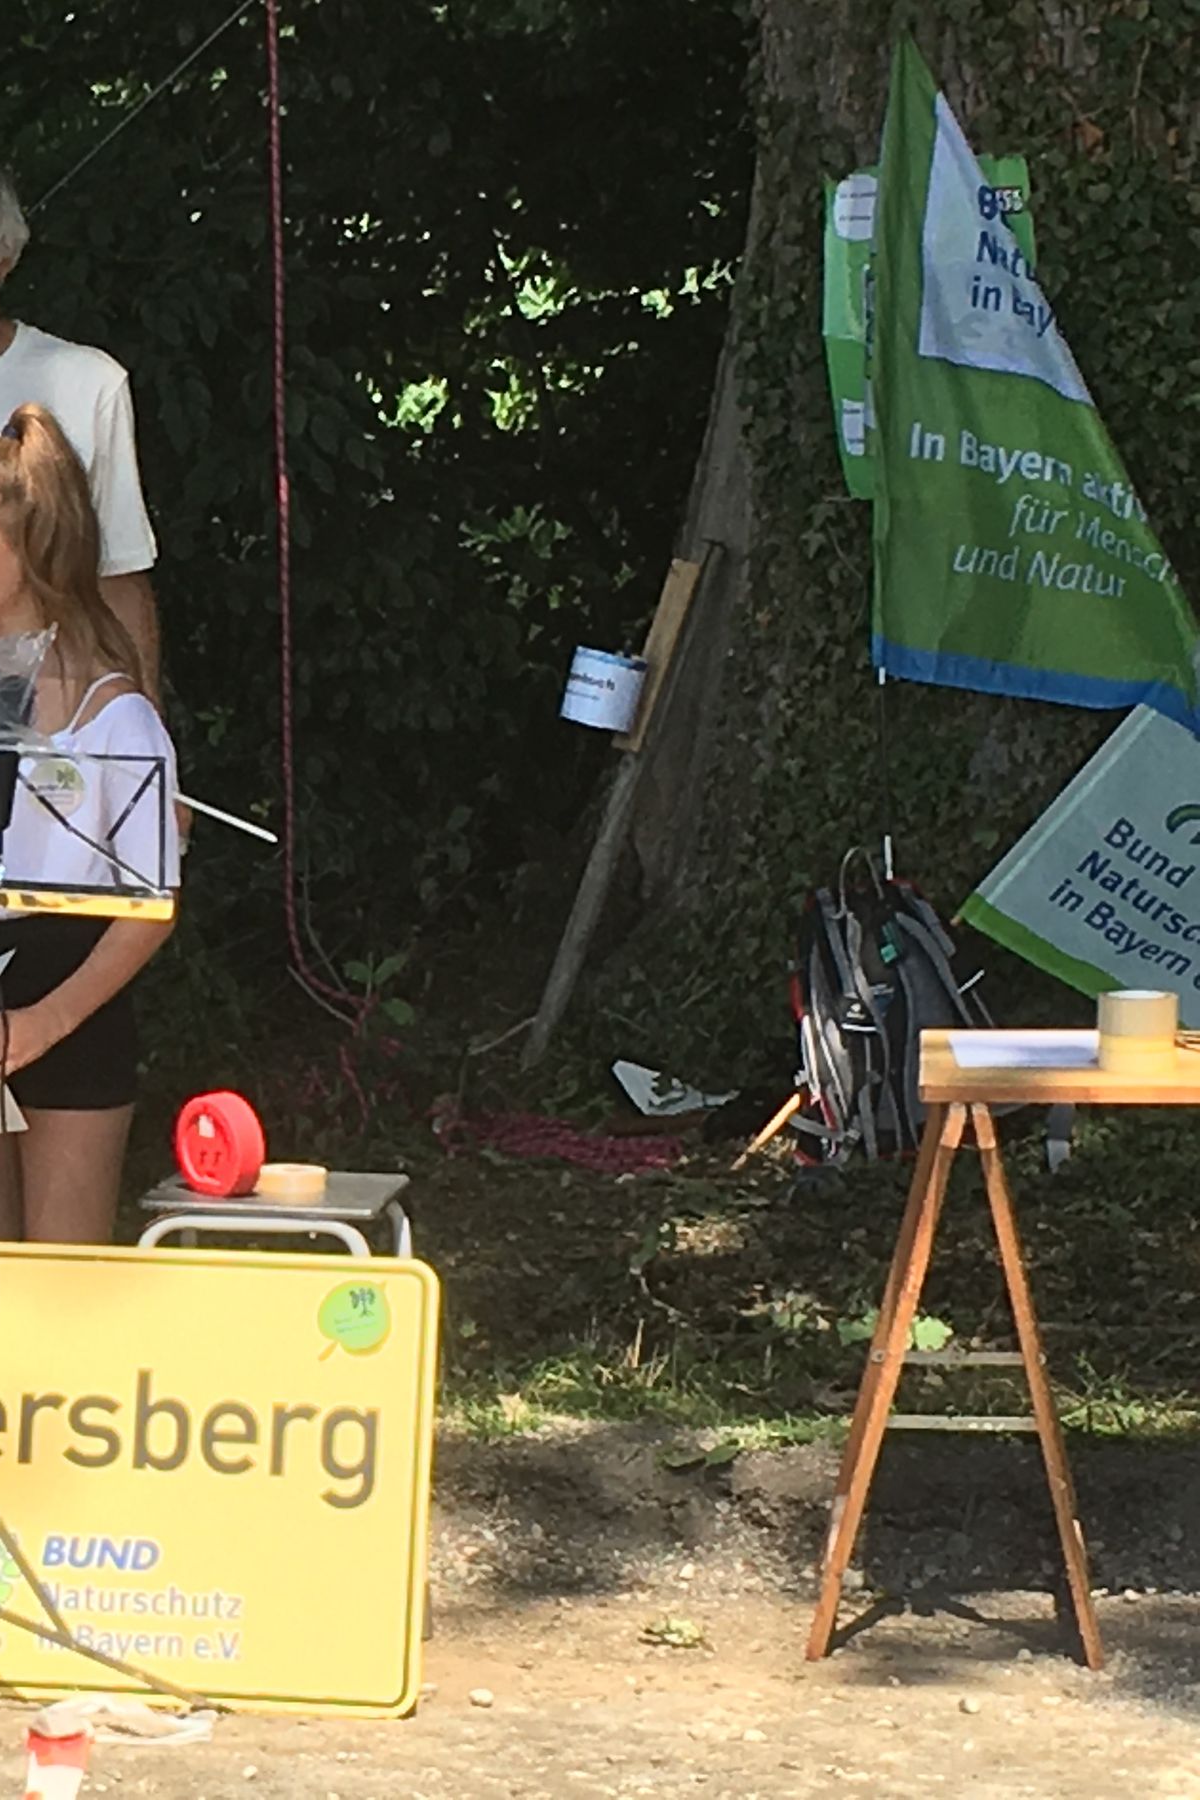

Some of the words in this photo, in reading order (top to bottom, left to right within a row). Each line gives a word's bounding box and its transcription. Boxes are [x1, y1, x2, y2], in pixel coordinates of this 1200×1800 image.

[972, 275, 1002, 311] in
[910, 422, 945, 461] In
[960, 430, 1073, 486] Bayern
[1009, 494, 1069, 537] für
[953, 545, 1020, 581] und
[1103, 817, 1197, 888] Bund
[1076, 850, 1200, 944] Natursc
[1048, 878, 1084, 914] in
[1084, 901, 1192, 976] Bayern
[42, 1535, 160, 1571] BUND
[41, 1581, 242, 1619] Naturschutz
[74, 1624, 183, 1658] Bayern
[194, 1632, 240, 1660] e.V.
